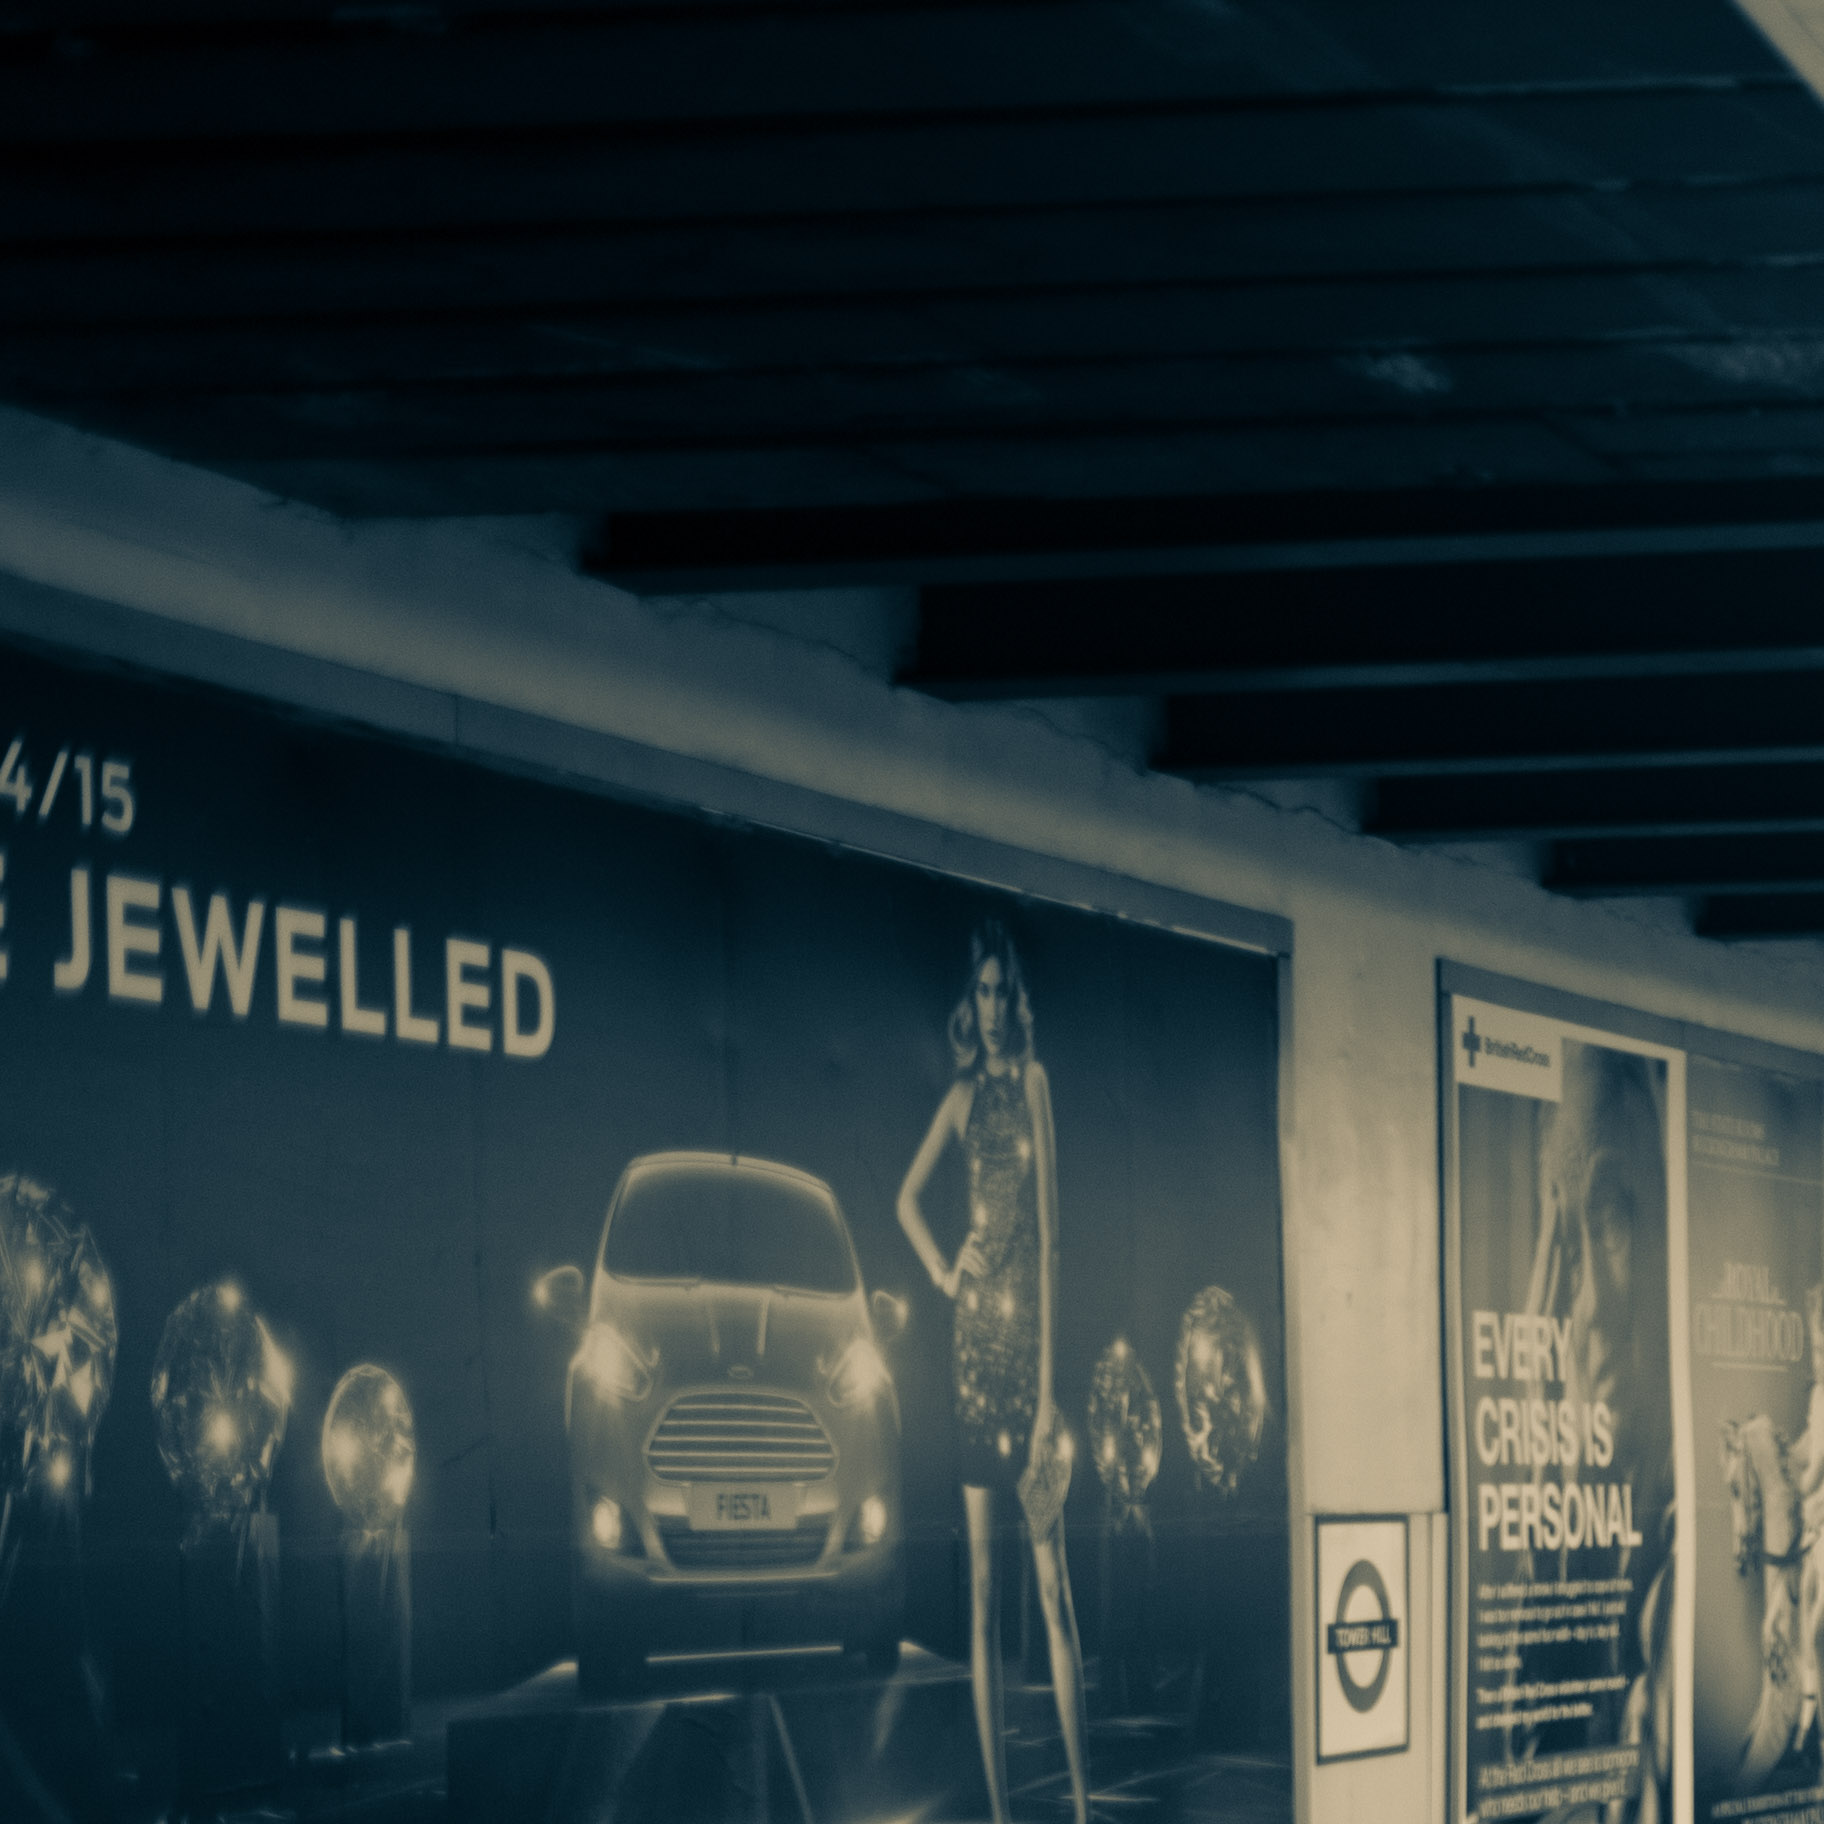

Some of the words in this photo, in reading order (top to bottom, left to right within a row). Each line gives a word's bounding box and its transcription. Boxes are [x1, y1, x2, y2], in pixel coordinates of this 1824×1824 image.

[54, 866, 557, 1058] JEWELLED
[1474, 1311, 1573, 1382] EVERY
[1475, 1397, 1578, 1466] CRISIS
[1584, 1402, 1613, 1467] IS
[716, 1493, 770, 1521] FIESTA
[1479, 1483, 1643, 1551] PERSONAL
[1335, 1624, 1370, 1644] TOWER
[1371, 1622, 1392, 1640] HILL
